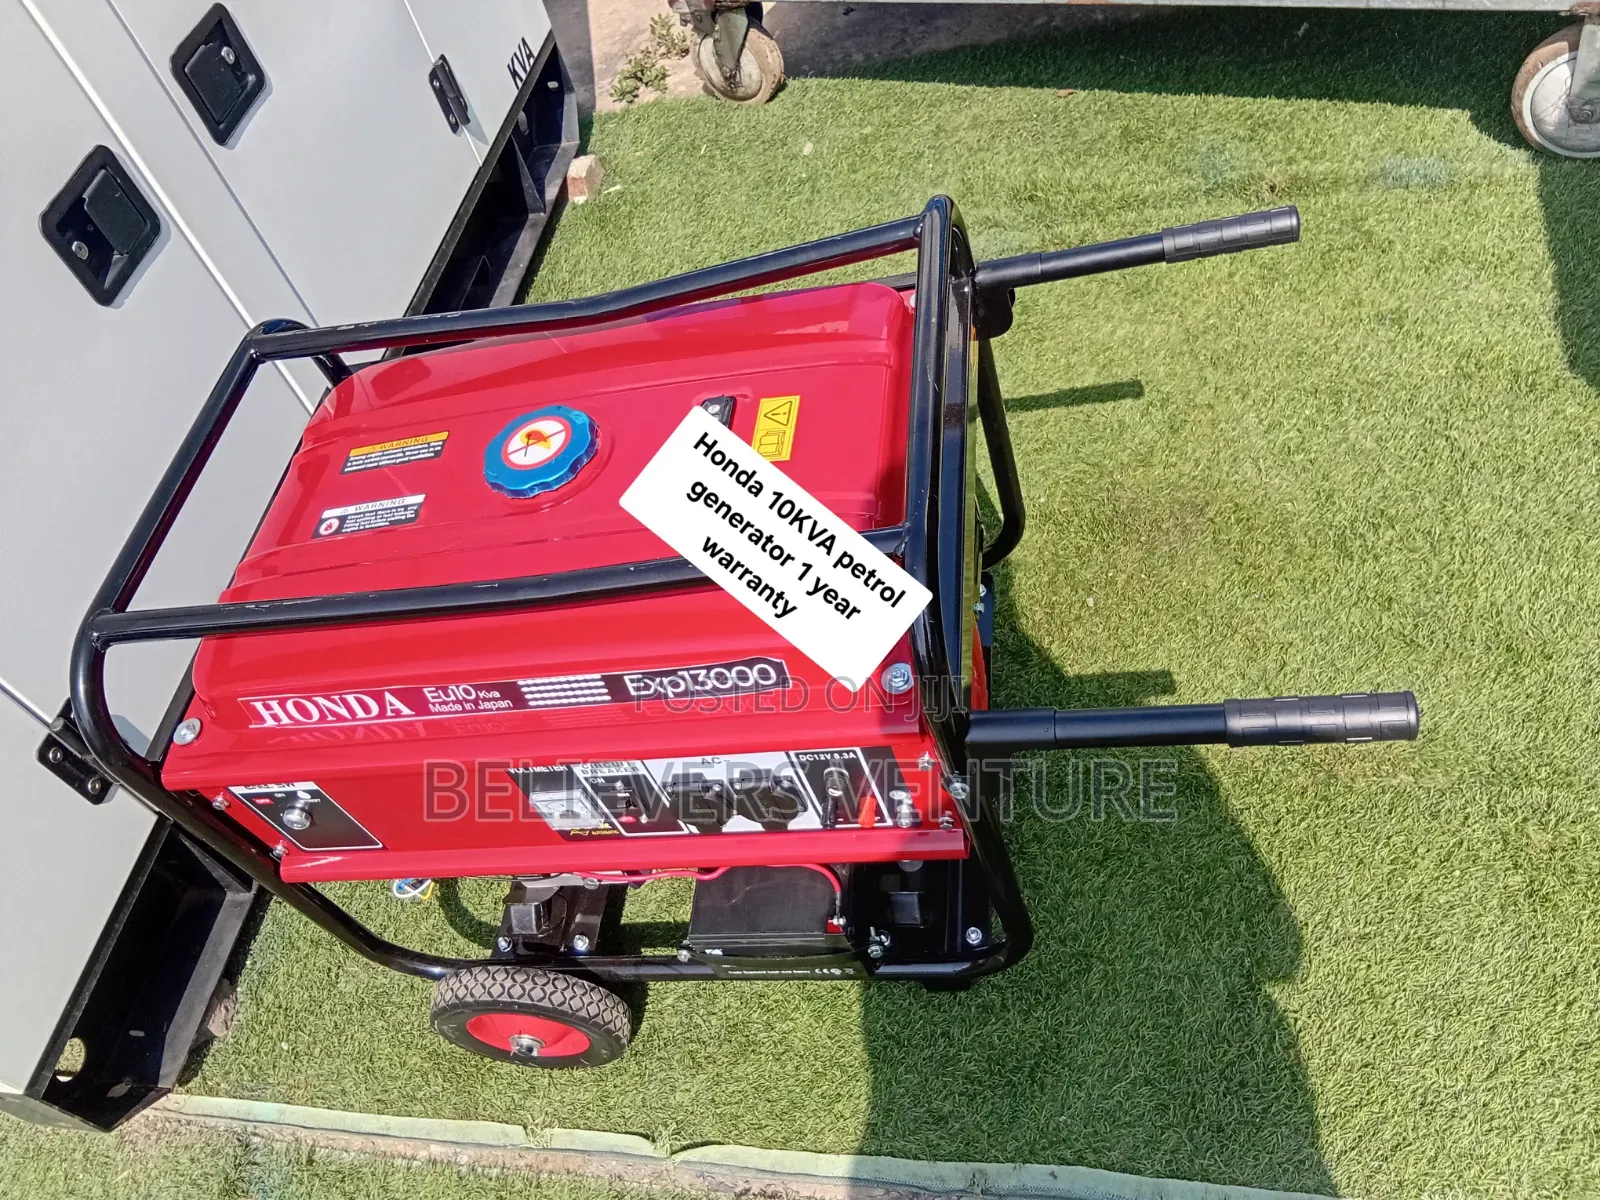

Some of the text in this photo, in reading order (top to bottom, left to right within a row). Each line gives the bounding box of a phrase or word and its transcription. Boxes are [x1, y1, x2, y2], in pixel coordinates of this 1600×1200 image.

[507, 36, 536, 90] KVA
[380, 436, 428, 449] WARNING
[355, 498, 405, 512] WARNING
[250, 691, 415, 728] HONDA
[478, 689, 501, 700] Kva
[429, 699, 513, 714] Made in Japan
[798, 753, 832, 762] DC12V
[507, 765, 569, 774] VOLTMETER
[581, 767, 640, 775] BREAKER
